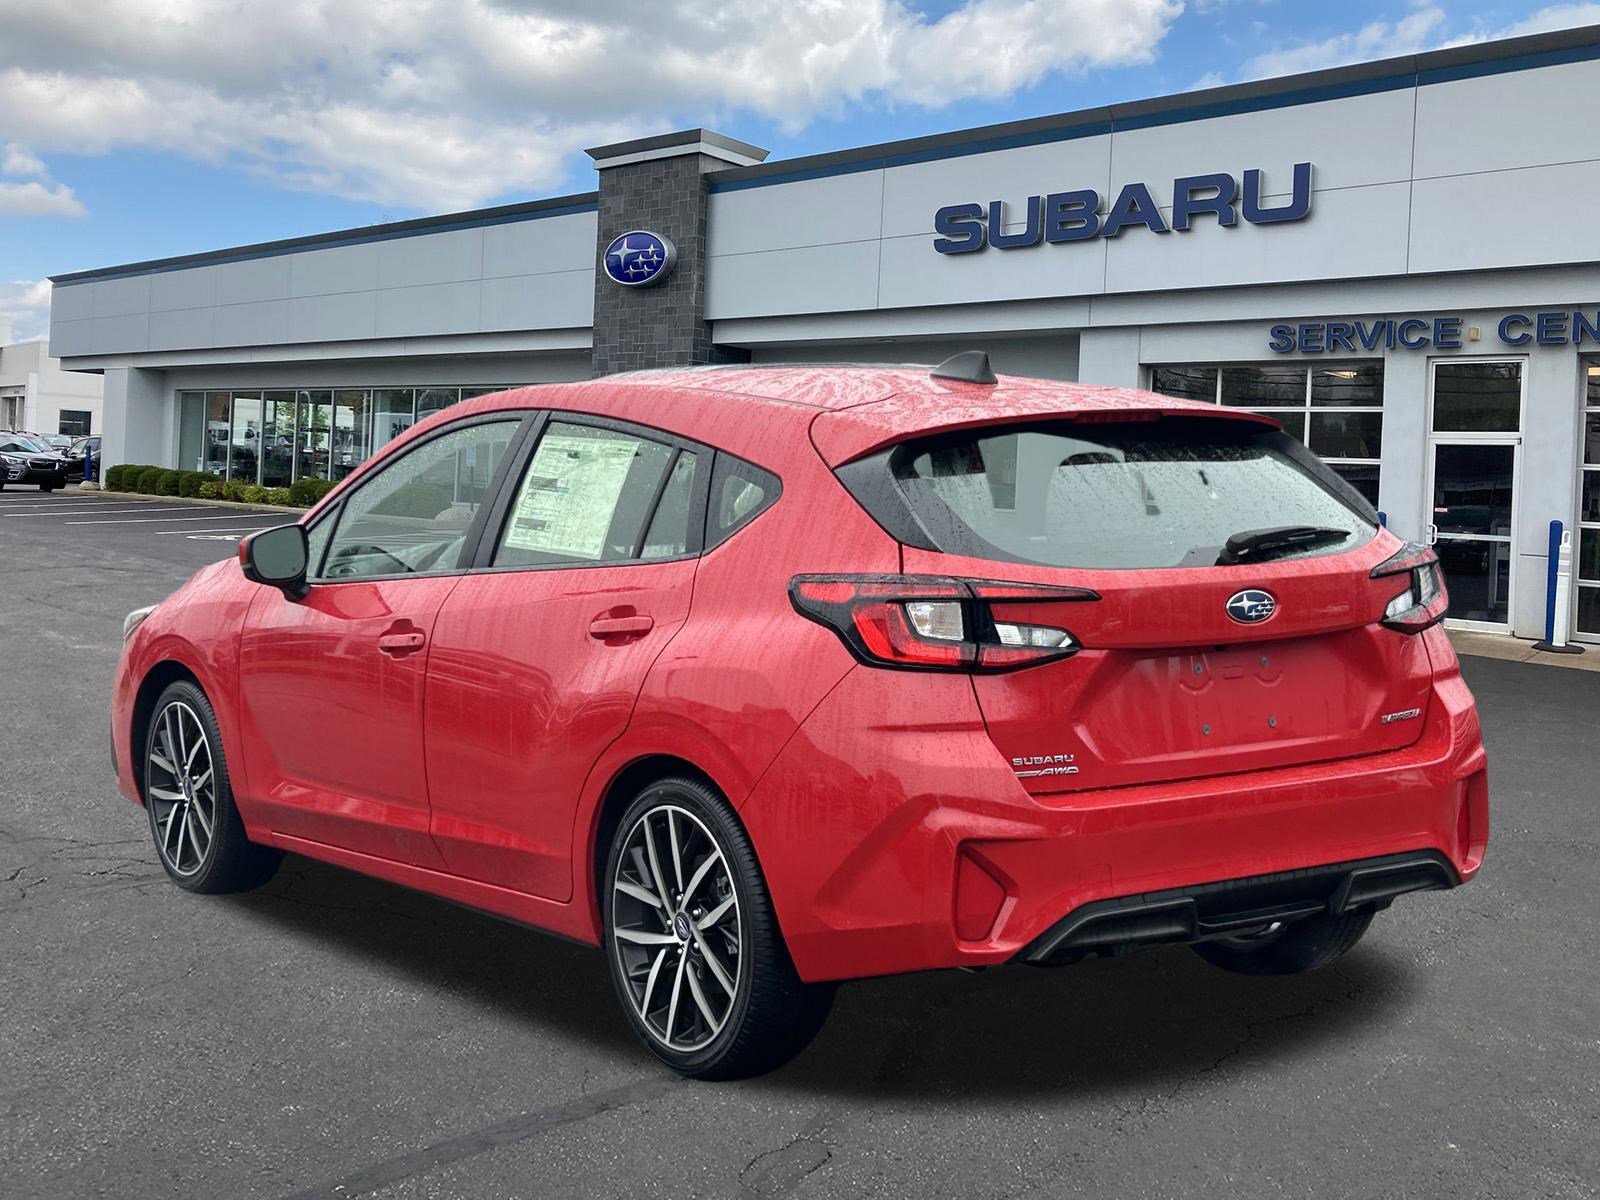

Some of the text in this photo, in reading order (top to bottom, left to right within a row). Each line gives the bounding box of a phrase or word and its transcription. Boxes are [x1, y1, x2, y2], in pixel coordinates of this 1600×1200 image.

[933, 161, 1313, 255] SUBARU
[1269, 310, 1600, 353] SERVICE CEN
[1012, 754, 1075, 766] SUBARU
[1037, 766, 1080, 777] AWD
